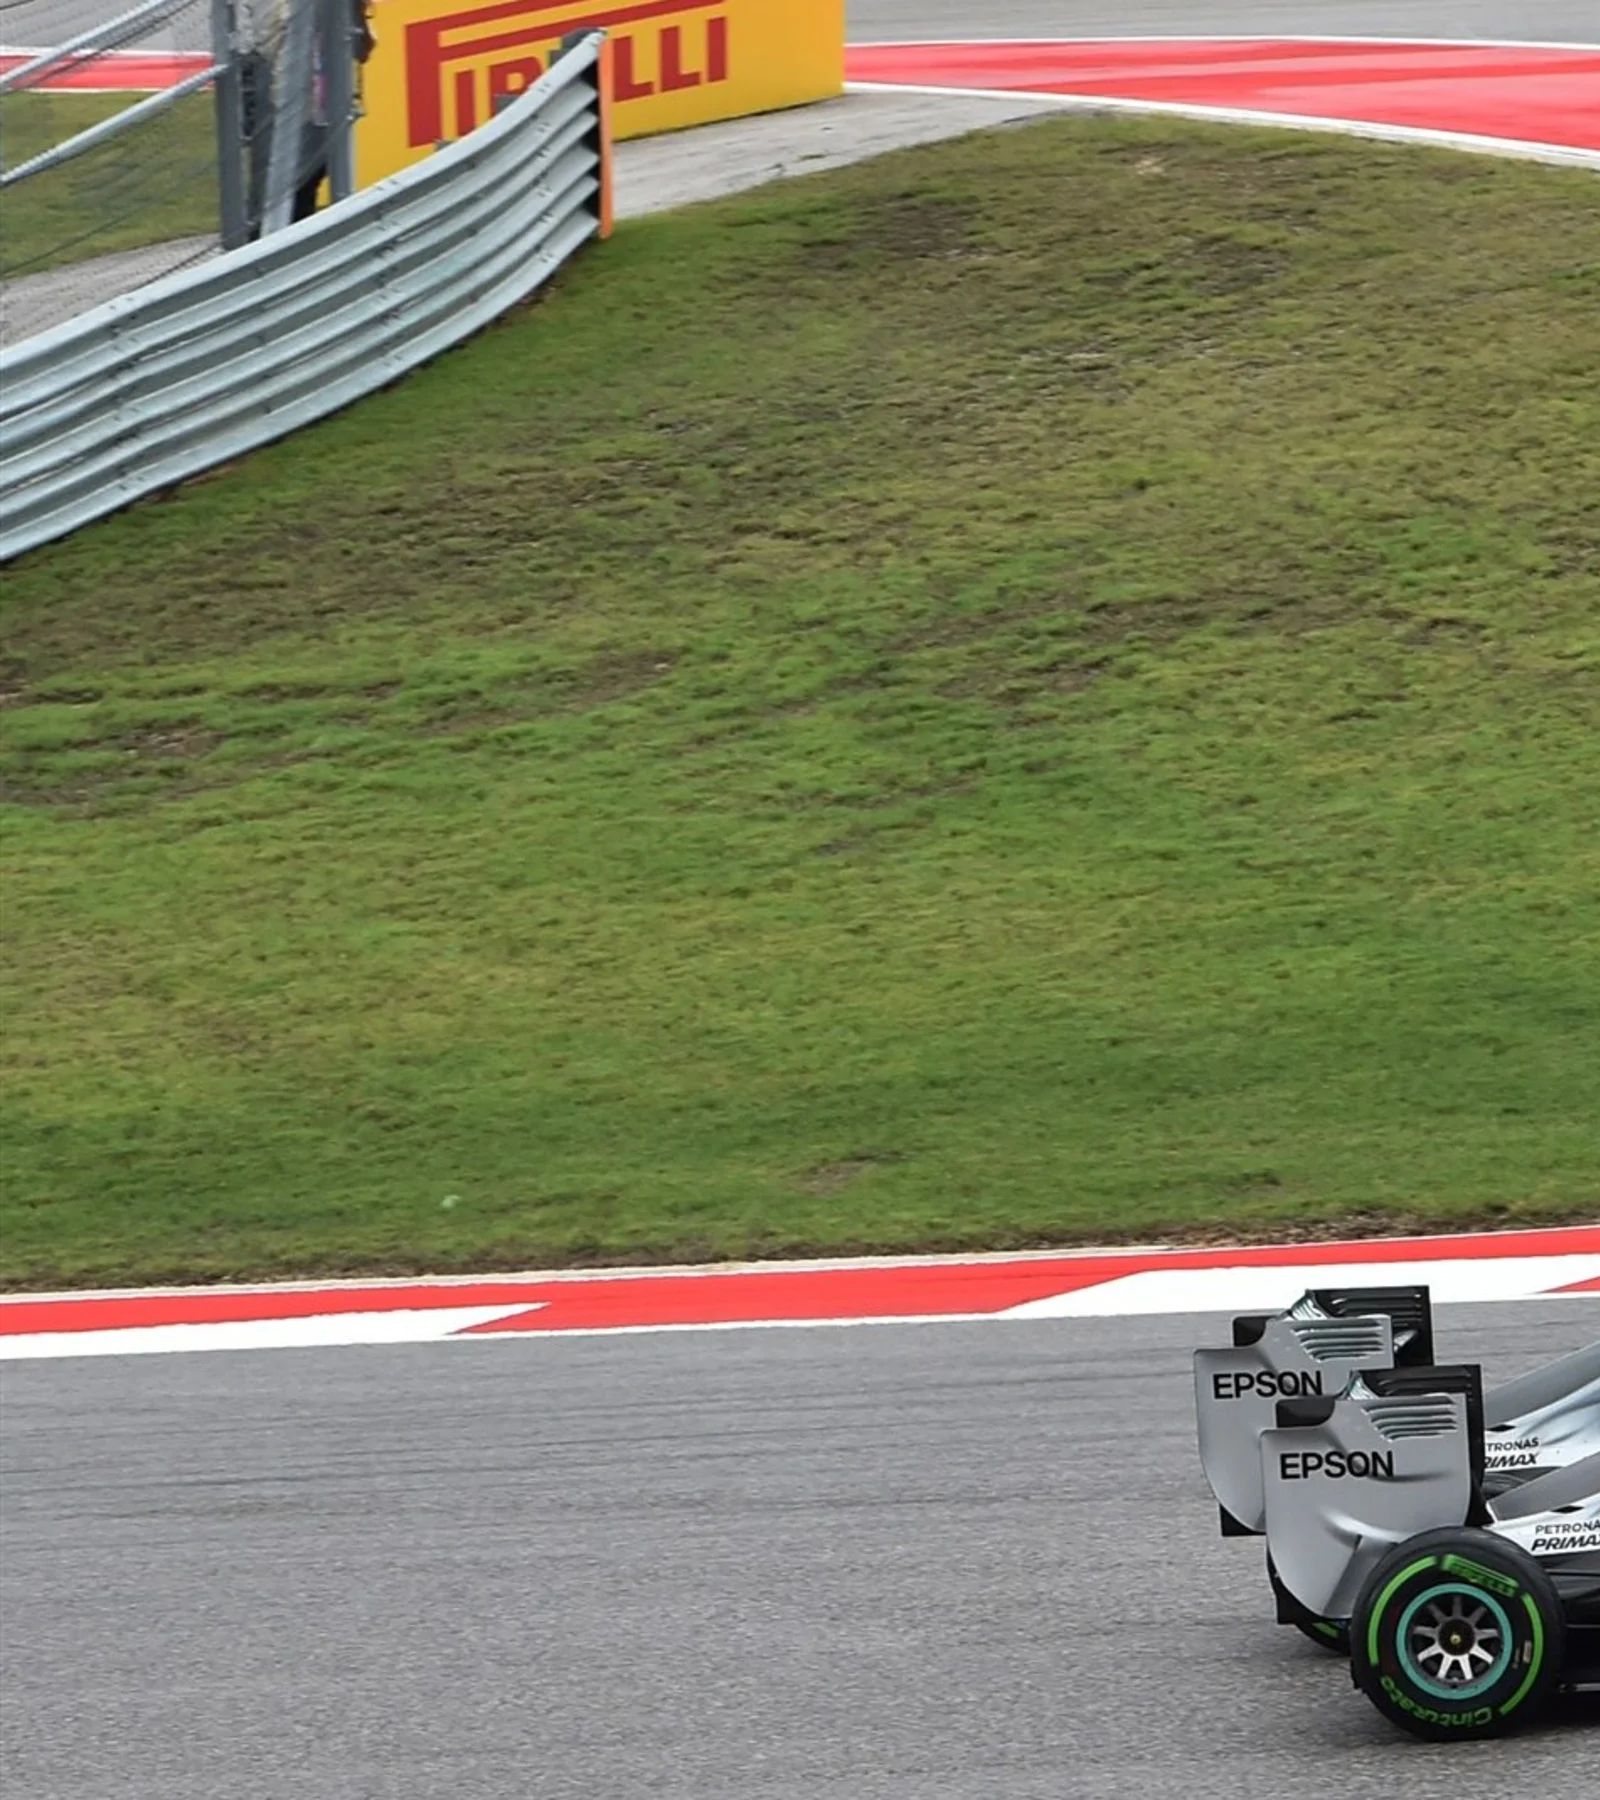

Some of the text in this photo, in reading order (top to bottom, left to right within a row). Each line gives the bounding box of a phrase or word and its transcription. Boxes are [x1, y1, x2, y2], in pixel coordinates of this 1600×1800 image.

[404, 0, 728, 148] PIRLLI
[1212, 1370, 1323, 1399] EPSON
[1486, 1436, 1540, 1451] TRONAS
[1279, 1451, 1395, 1480] EPSON
[1484, 1453, 1541, 1469] RIMAX
